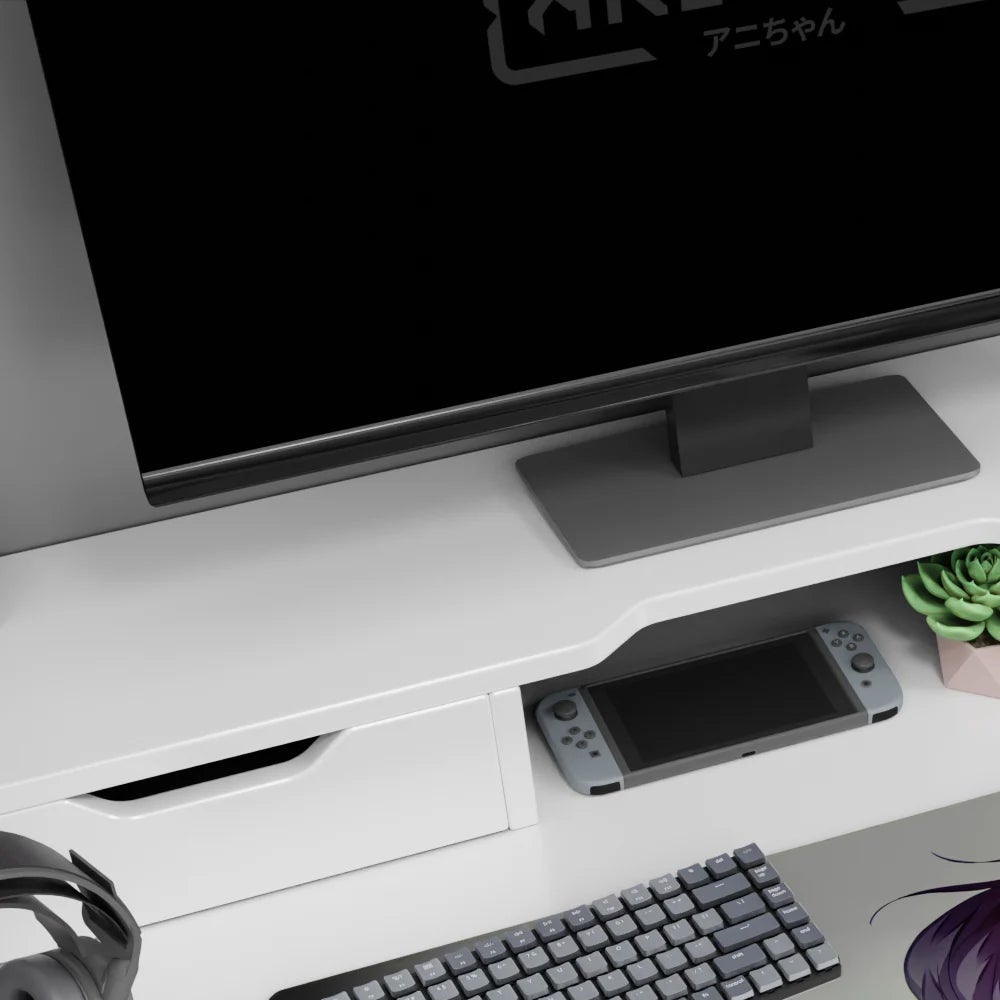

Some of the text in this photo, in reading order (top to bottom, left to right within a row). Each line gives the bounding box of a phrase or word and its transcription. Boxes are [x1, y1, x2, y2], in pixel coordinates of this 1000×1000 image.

[703, 7, 846, 57] アニちゃん
